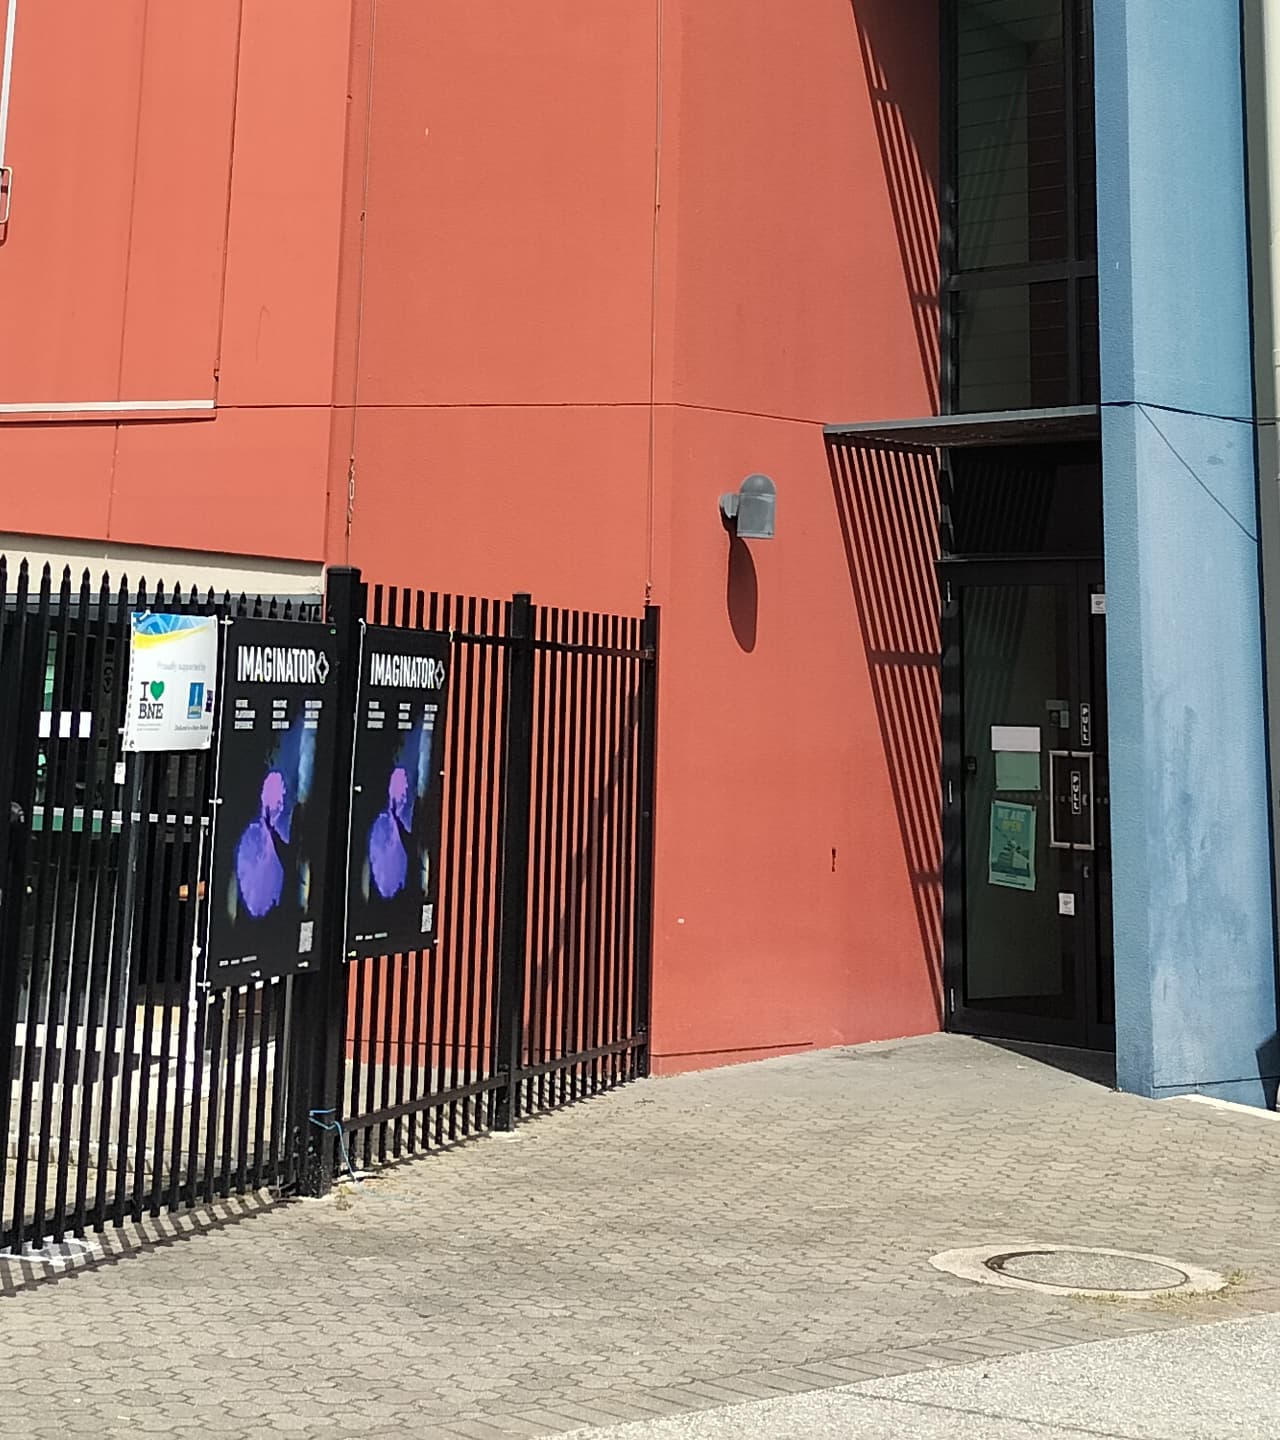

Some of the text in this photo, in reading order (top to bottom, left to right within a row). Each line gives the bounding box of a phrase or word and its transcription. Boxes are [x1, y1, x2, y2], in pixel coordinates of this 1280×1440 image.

[237, 645, 316, 683] IMAGINATOR
[370, 652, 435, 689] IMAGINATOR
[139, 681, 150, 702] I
[137, 702, 164, 720] BNE
